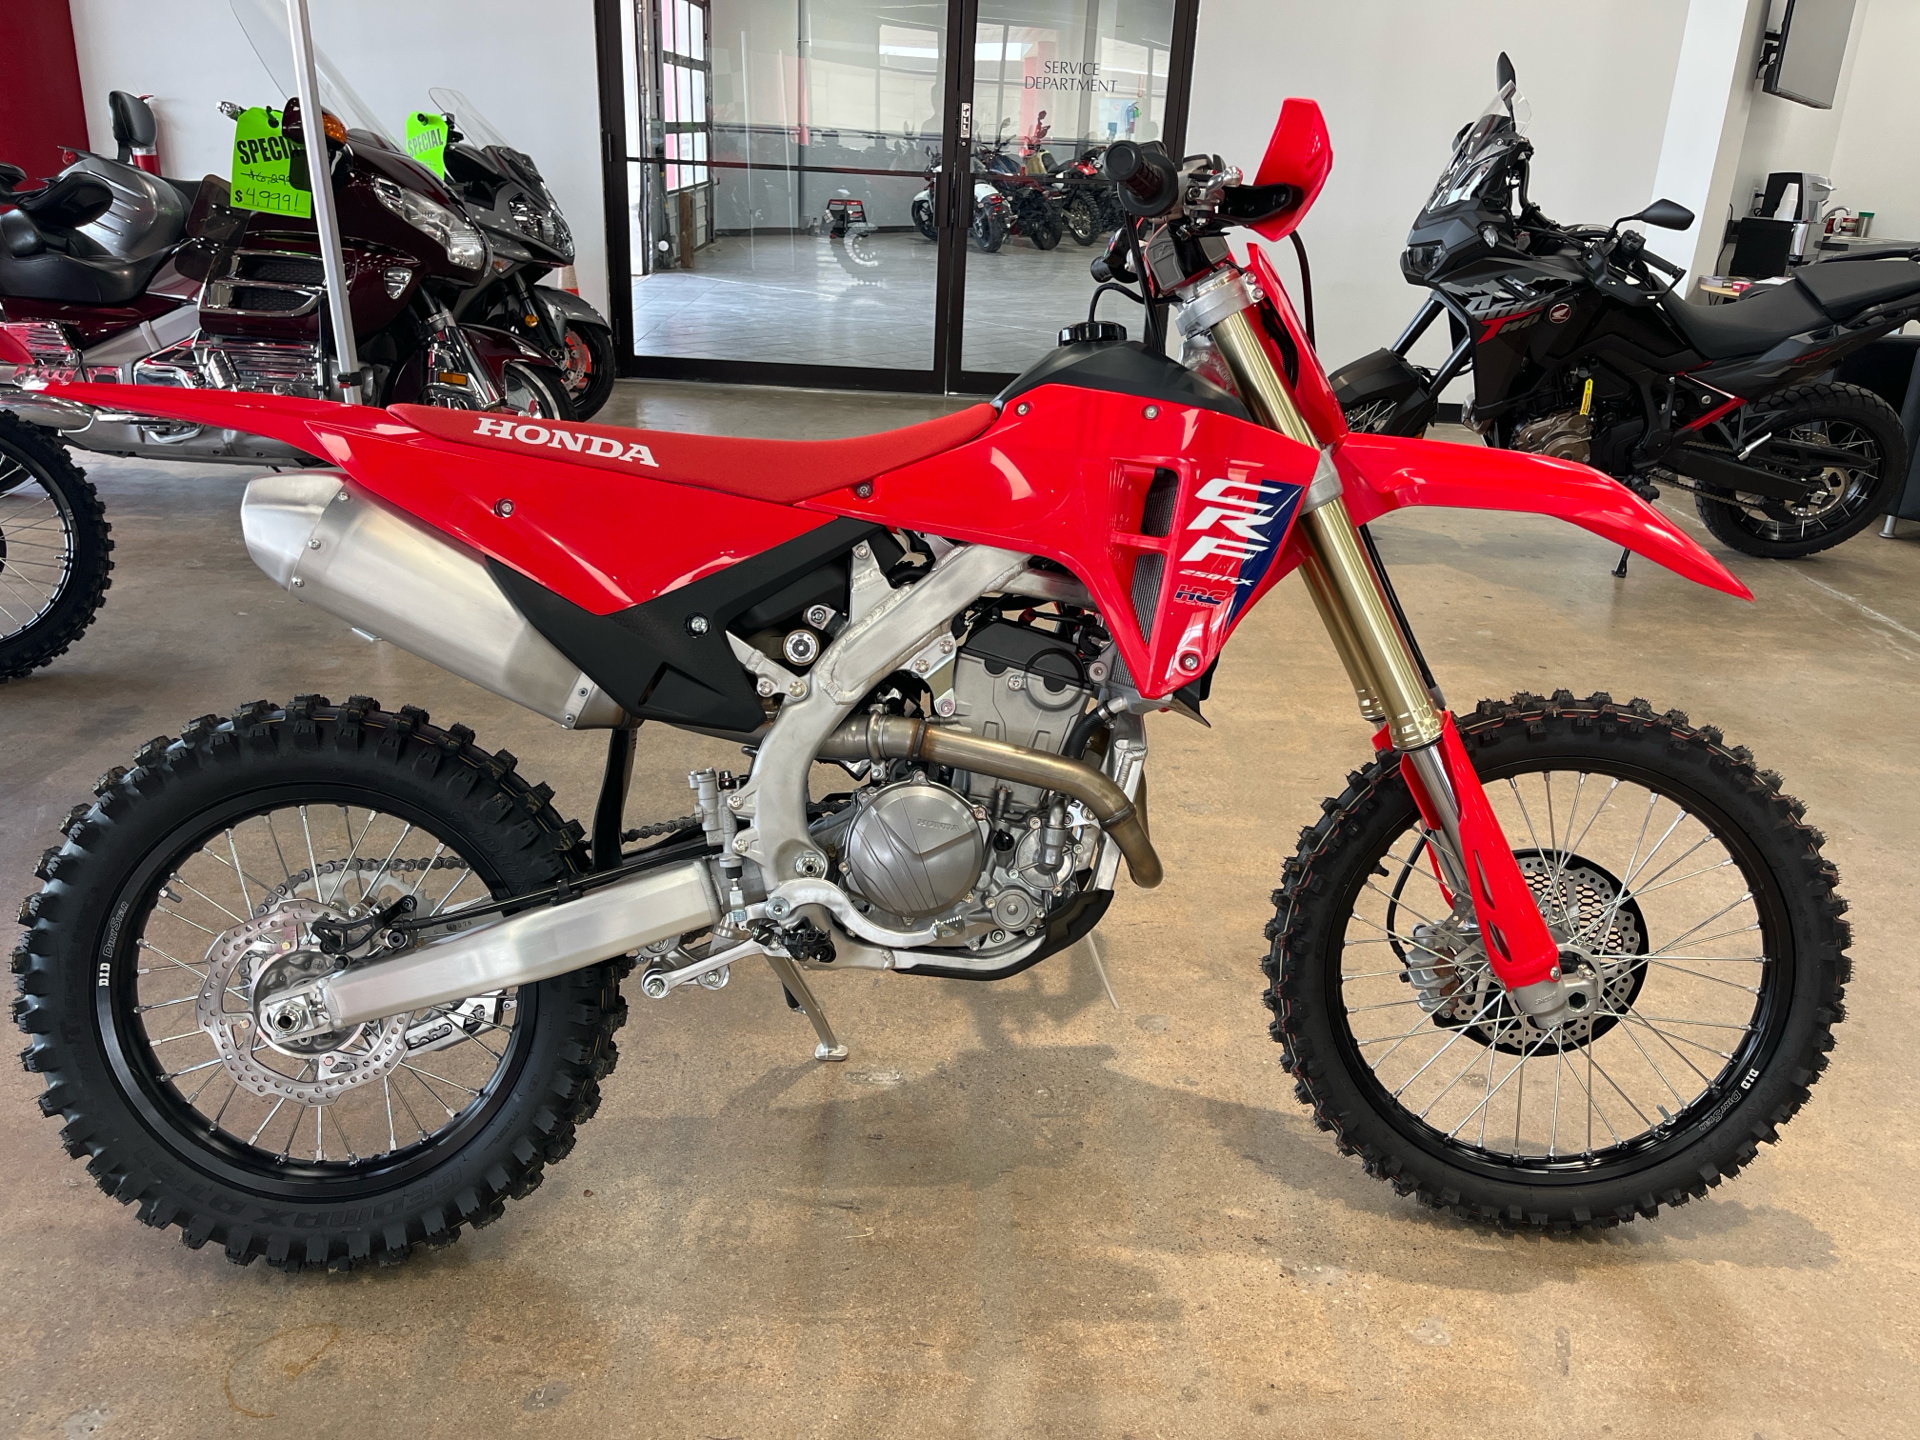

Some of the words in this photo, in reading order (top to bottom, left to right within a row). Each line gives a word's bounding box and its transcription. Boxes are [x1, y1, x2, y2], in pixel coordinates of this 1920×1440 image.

[1044, 60, 1100, 76] SERVICE
[1025, 75, 1118, 93] DEPARTMENT
[407, 128, 444, 158] SPECIAL
[473, 417, 660, 468] HONDA
[1179, 477, 1283, 562] CRF
[1173, 584, 1228, 605] HRC
[98, 962, 111, 987] DID
[1740, 1068, 1760, 1090] DID
